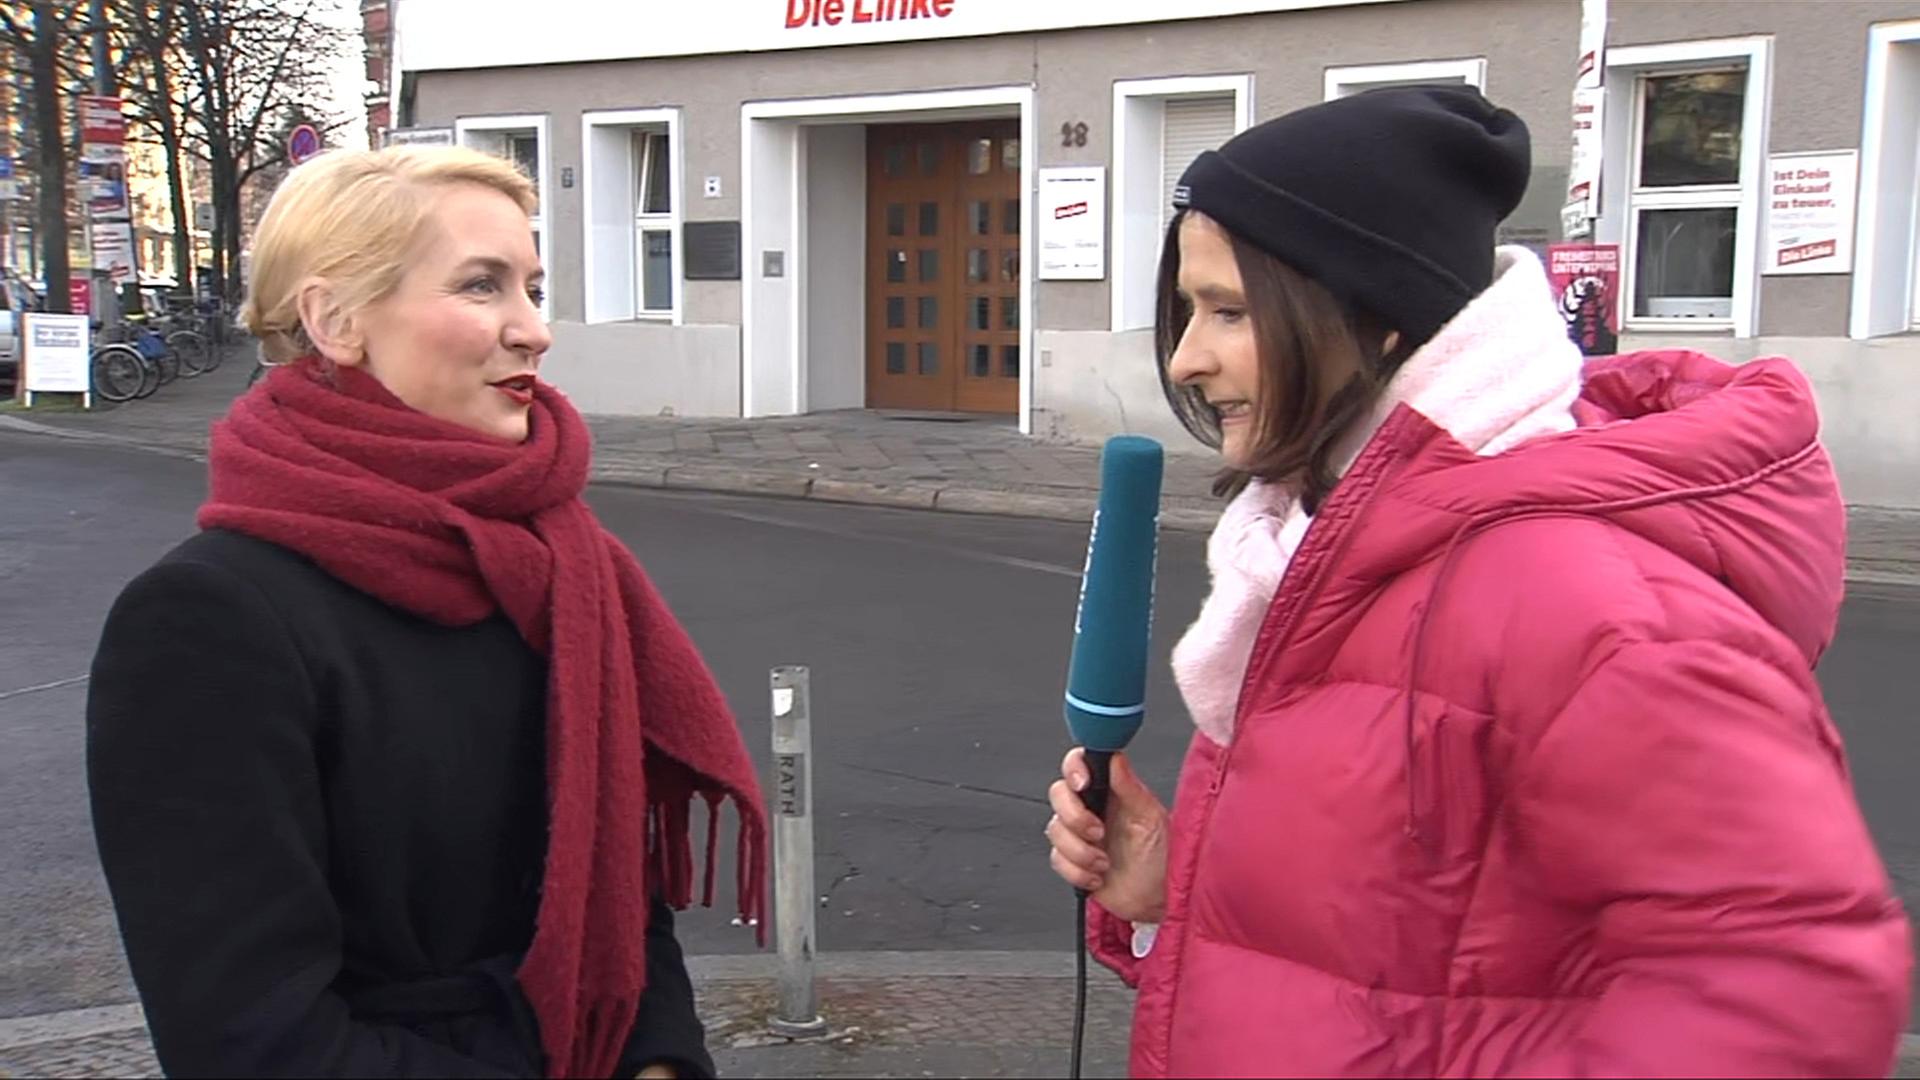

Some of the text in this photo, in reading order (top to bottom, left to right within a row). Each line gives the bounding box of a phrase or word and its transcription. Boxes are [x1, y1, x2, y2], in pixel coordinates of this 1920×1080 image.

[785, 0, 955, 29] Die Linke
[1773, 167, 1830, 181] Ist Dein
[1773, 181, 1832, 195] Einkauf
[1772, 198, 1836, 209] zu teuer.
[780, 756, 796, 814] RATH
